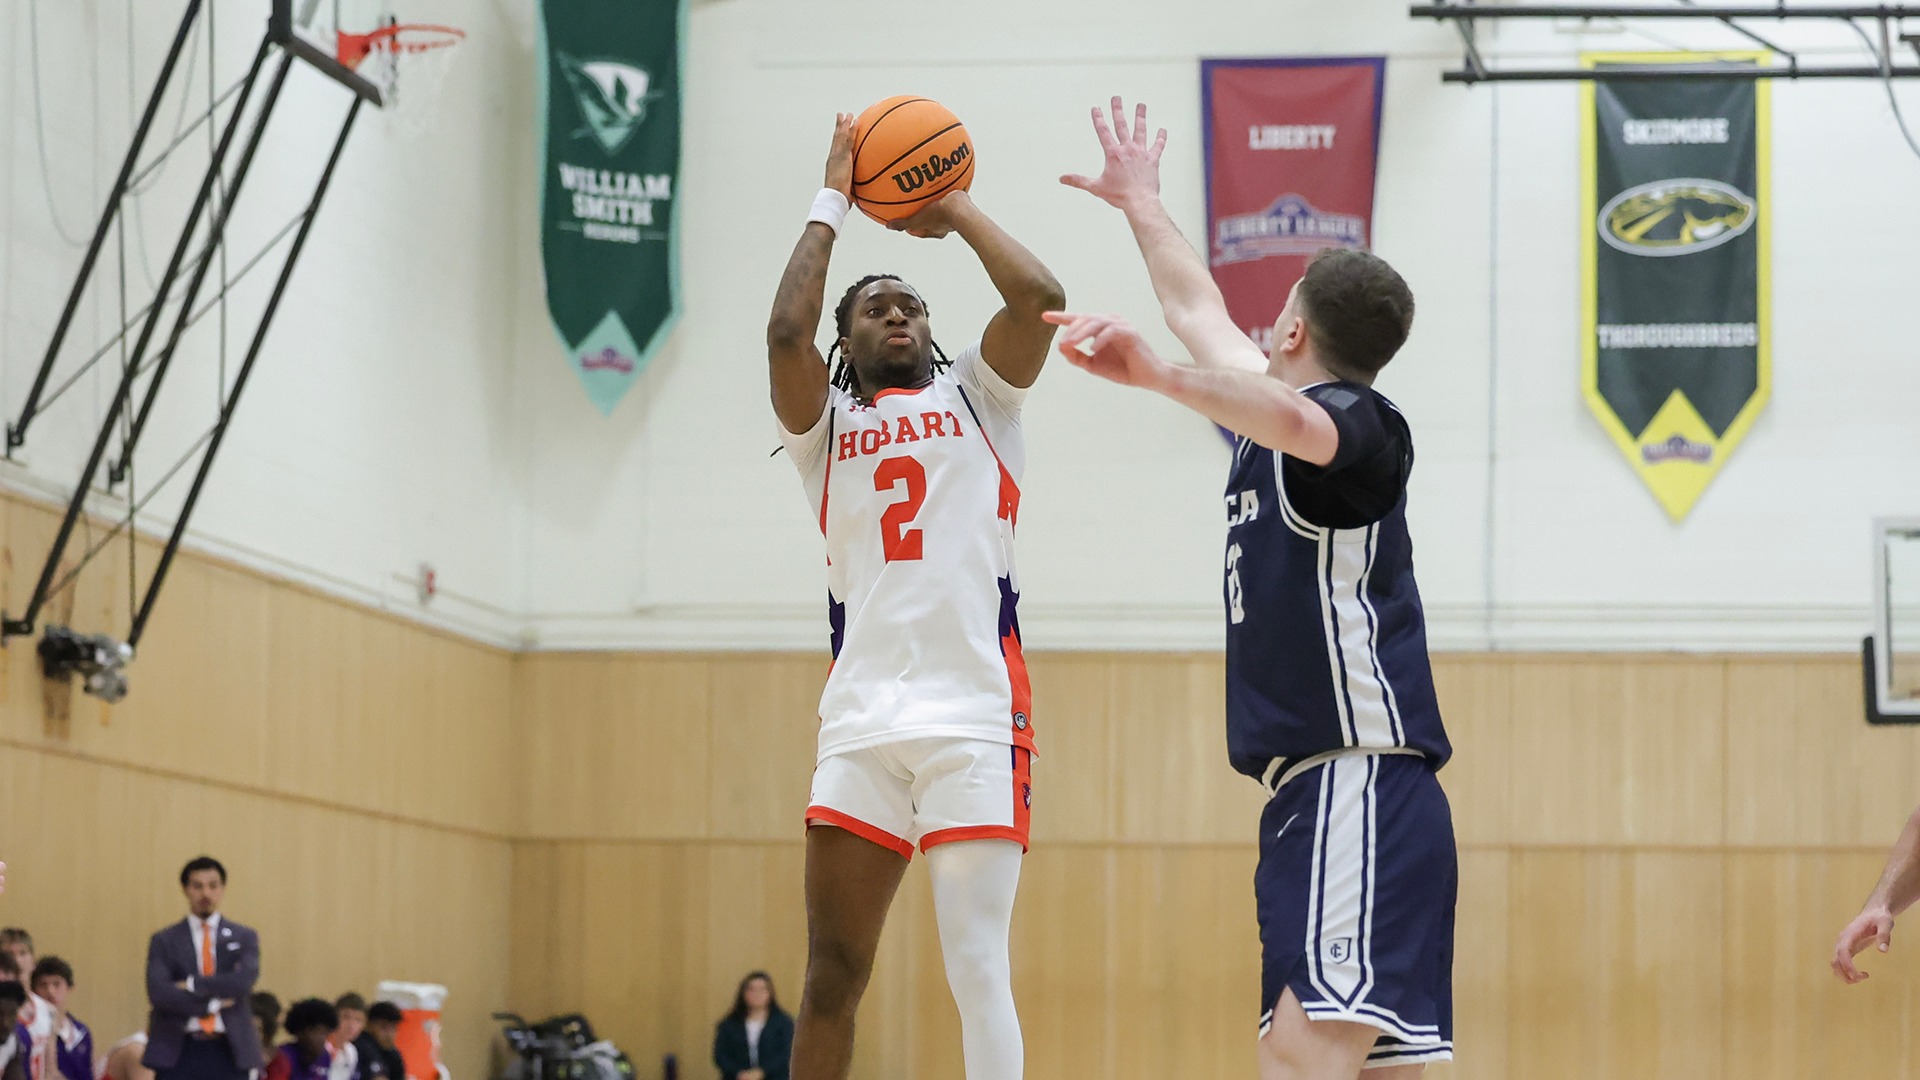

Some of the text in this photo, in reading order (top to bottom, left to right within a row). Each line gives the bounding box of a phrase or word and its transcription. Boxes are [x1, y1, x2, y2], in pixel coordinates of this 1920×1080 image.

[1248, 124, 1336, 150] LIBERTY
[1623, 118, 1729, 144] SKIDMORE
[559, 162, 671, 201] WILLIAM
[892, 142, 970, 193] Wilson
[572, 192, 653, 225] SMITH
[1597, 322, 1758, 348] THOROUGHBREDS
[838, 411, 963, 462] HOBART
[873, 455, 927, 565] 2
